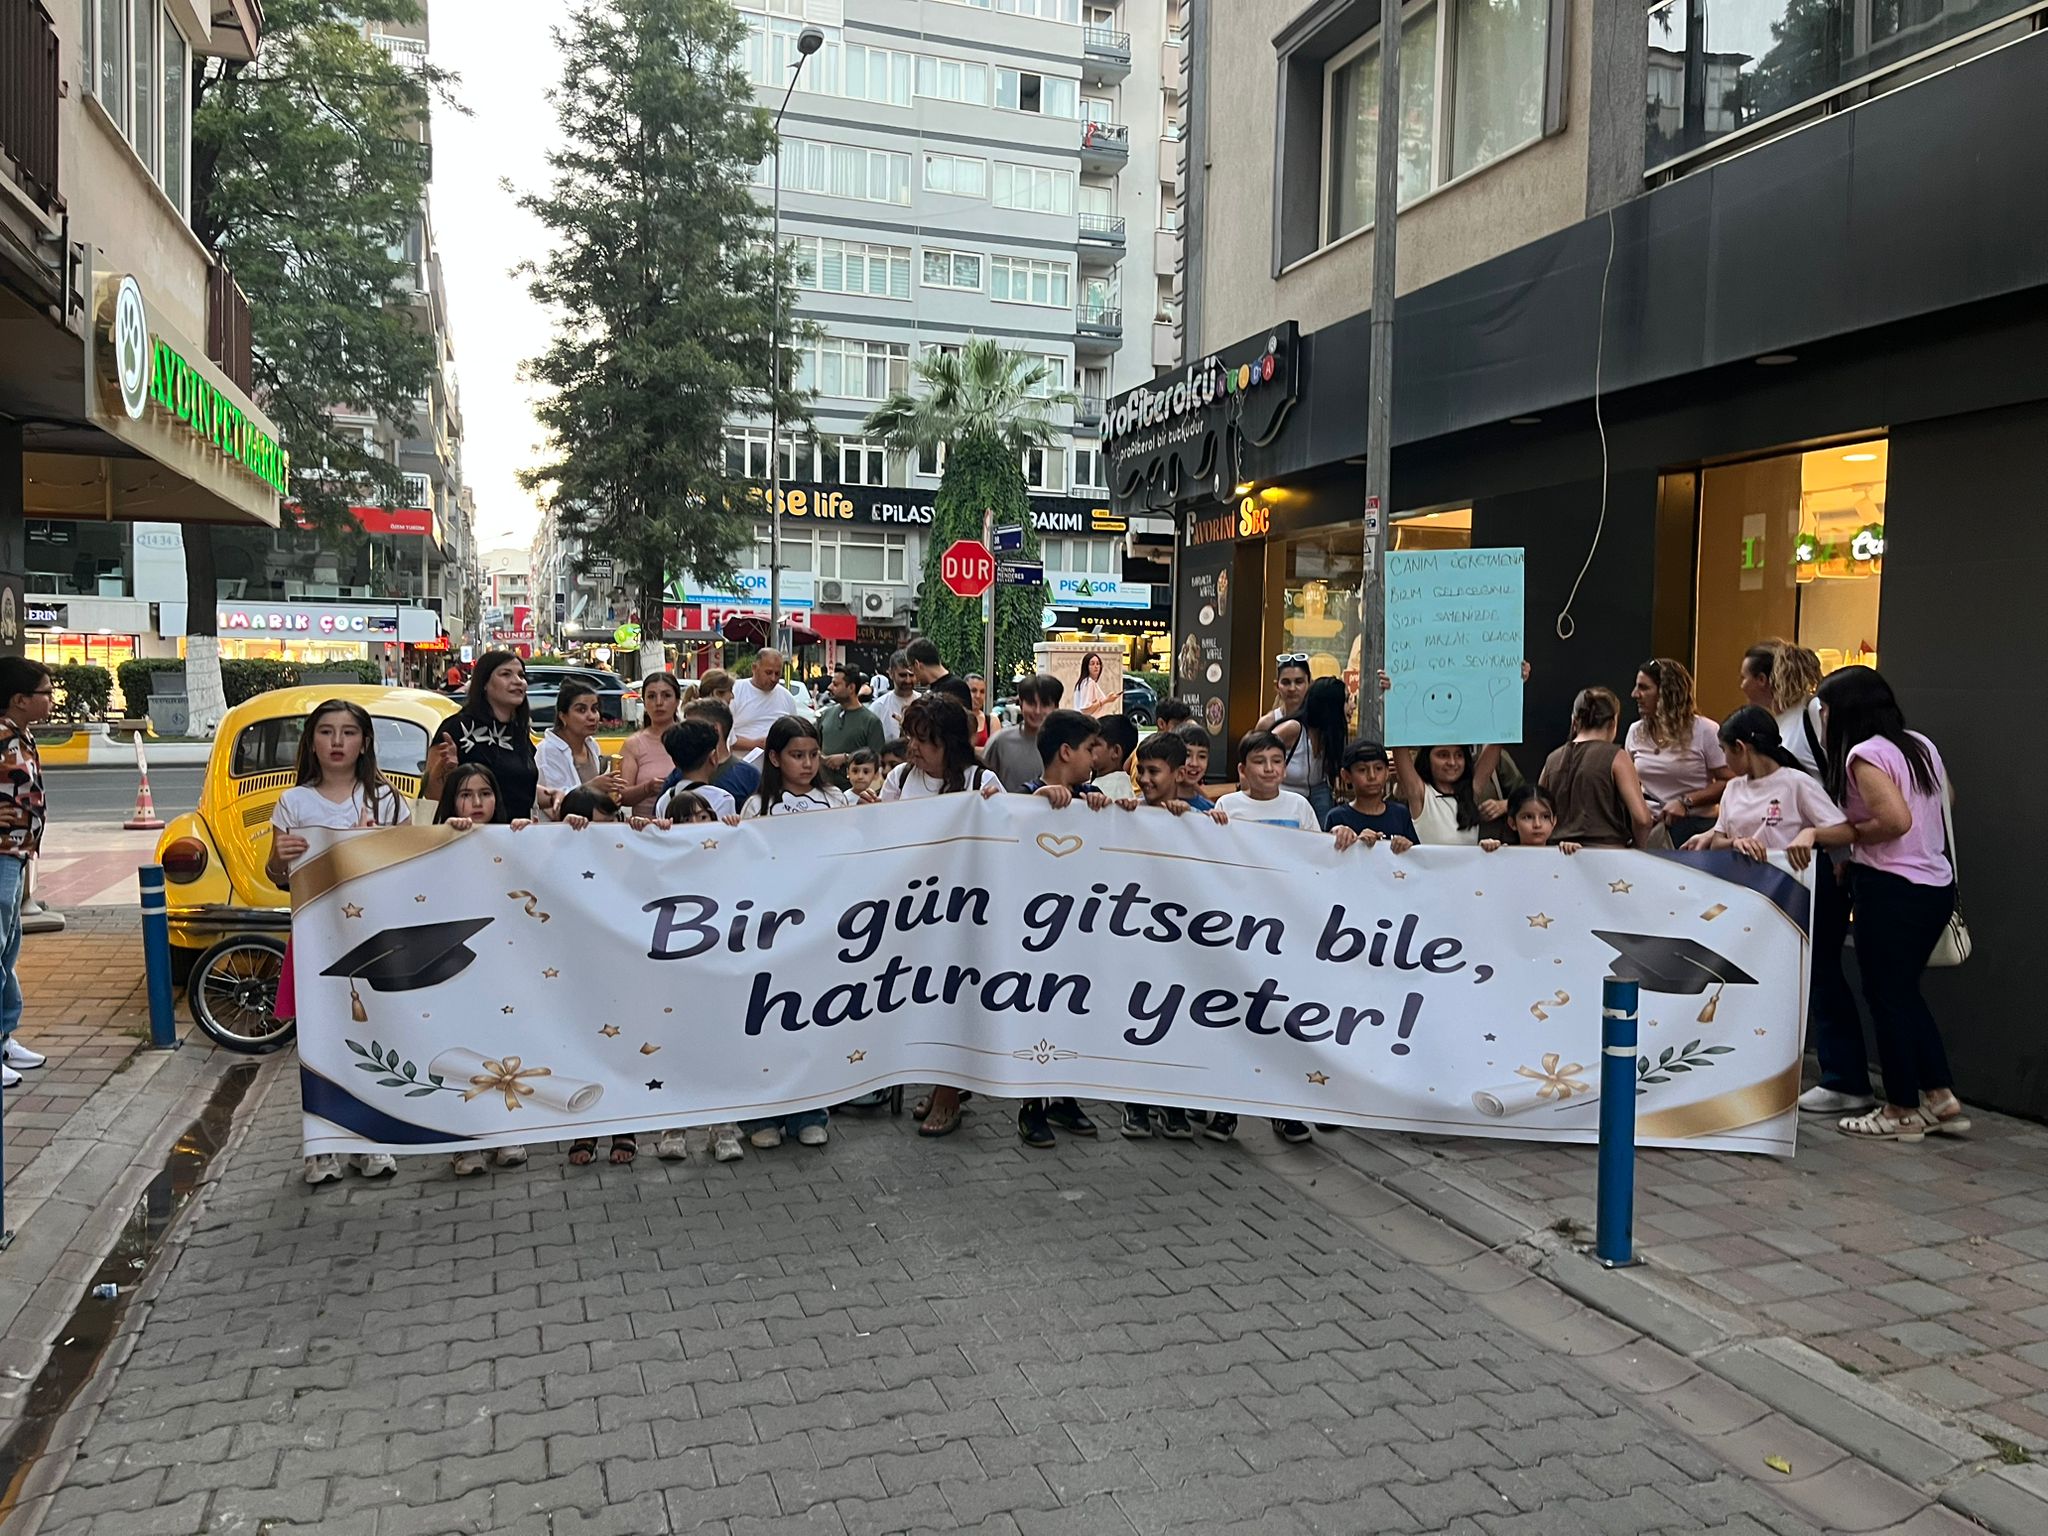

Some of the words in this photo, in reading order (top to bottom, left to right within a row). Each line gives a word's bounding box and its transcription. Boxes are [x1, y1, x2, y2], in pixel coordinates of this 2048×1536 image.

[150, 334, 211, 441] AYDIN
[213, 387, 242, 461] PET
[814, 491, 854, 519] life
[946, 557, 990, 580] DUR
[1390, 555, 1438, 576] CANIM
[24, 607, 57, 620] ERIN
[219, 612, 309, 631] IMARIK
[1081, 617, 1111, 626] ROYAL
[642, 893, 804, 963] Bir
[836, 878, 989, 963] gün
[1022, 882, 1284, 955] gitsen
[1316, 904, 1494, 982] bile,
[745, 955, 1090, 1036] hatıran
[1124, 977, 1423, 1057] yeter!
